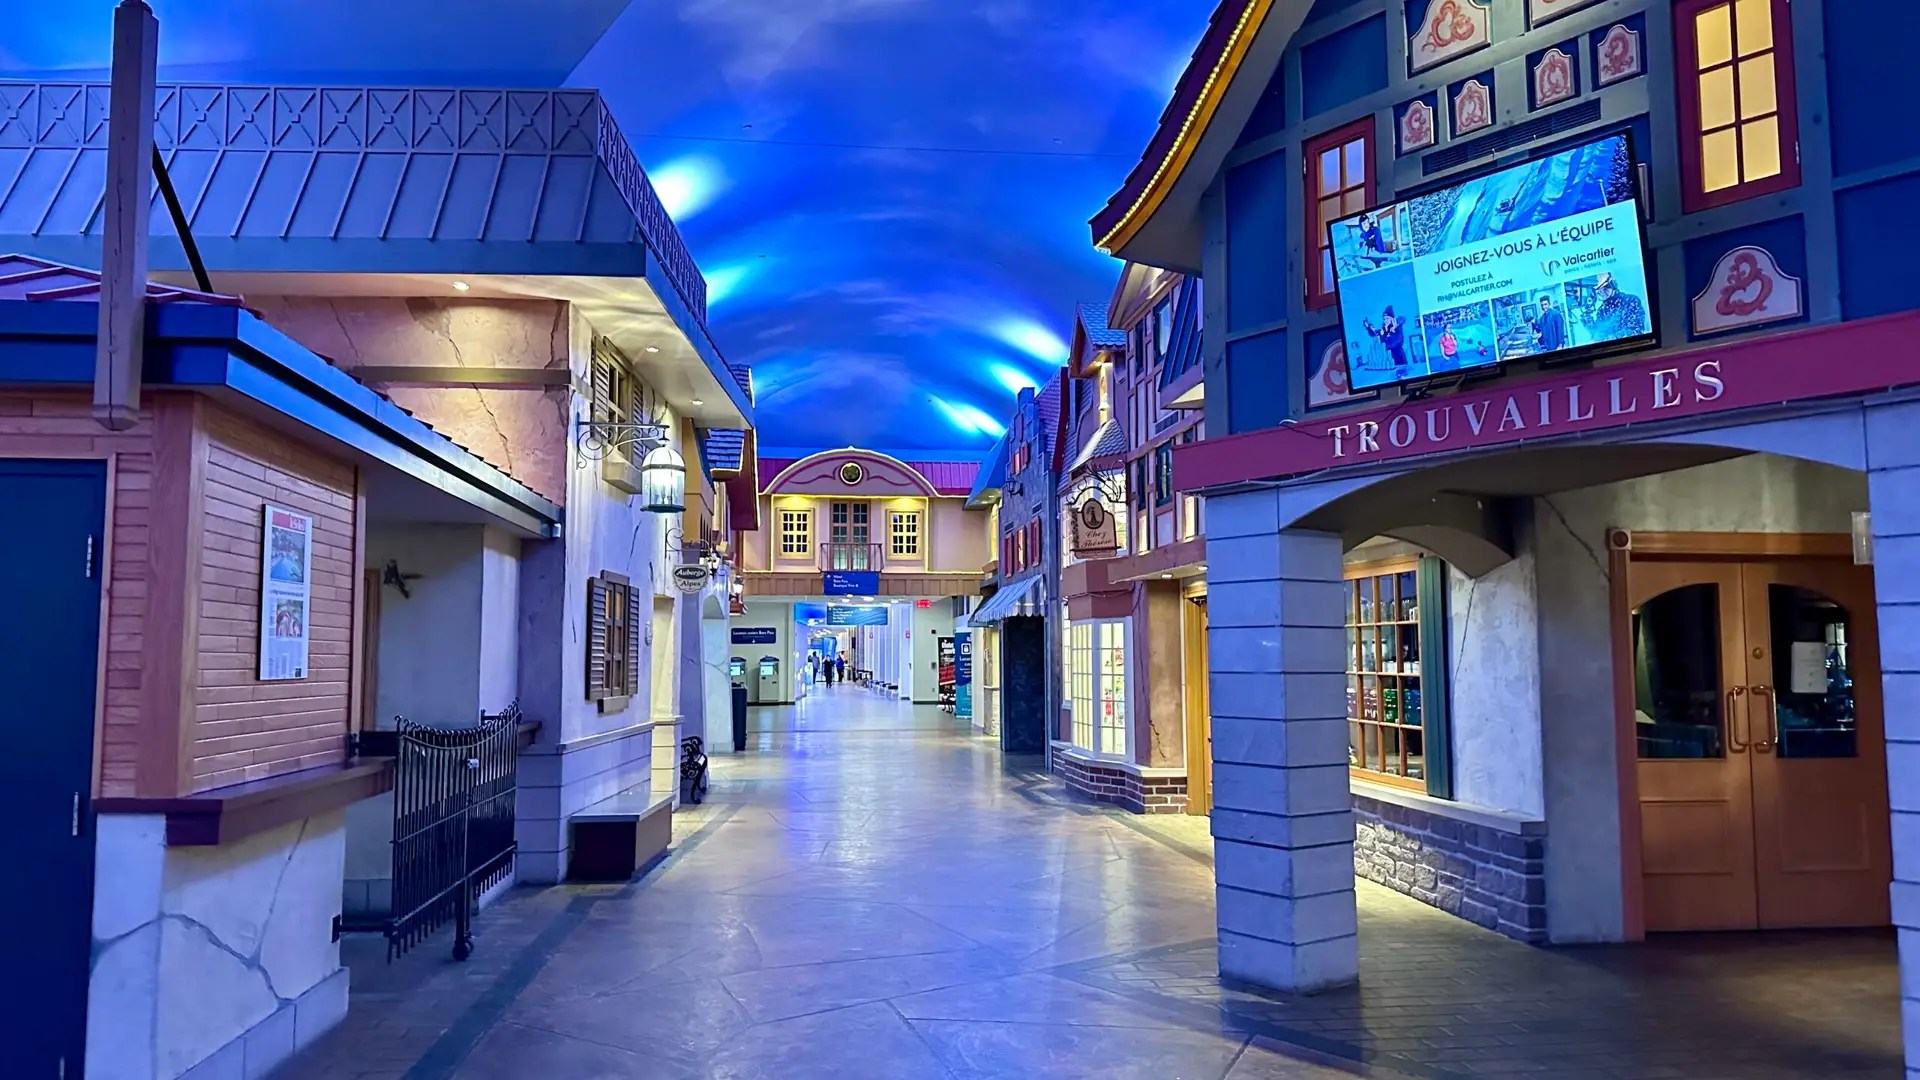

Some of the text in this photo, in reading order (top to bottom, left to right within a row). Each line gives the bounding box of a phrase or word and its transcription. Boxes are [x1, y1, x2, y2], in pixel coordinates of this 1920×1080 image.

[1434, 217, 1615, 275] JOIGNEZ-VOUS À L'ÉQUIPE
[1562, 247, 1616, 267] Valcartier
[1450, 274, 1486, 289] POSTULEZ
[1437, 278, 1513, 303] RH@VALCARTIER.COM
[1327, 360, 1725, 459] TROUVAILLES
[1085, 530, 1106, 539] Chez
[676, 569, 704, 578] Auberge
[680, 580, 701, 588] Alpes
